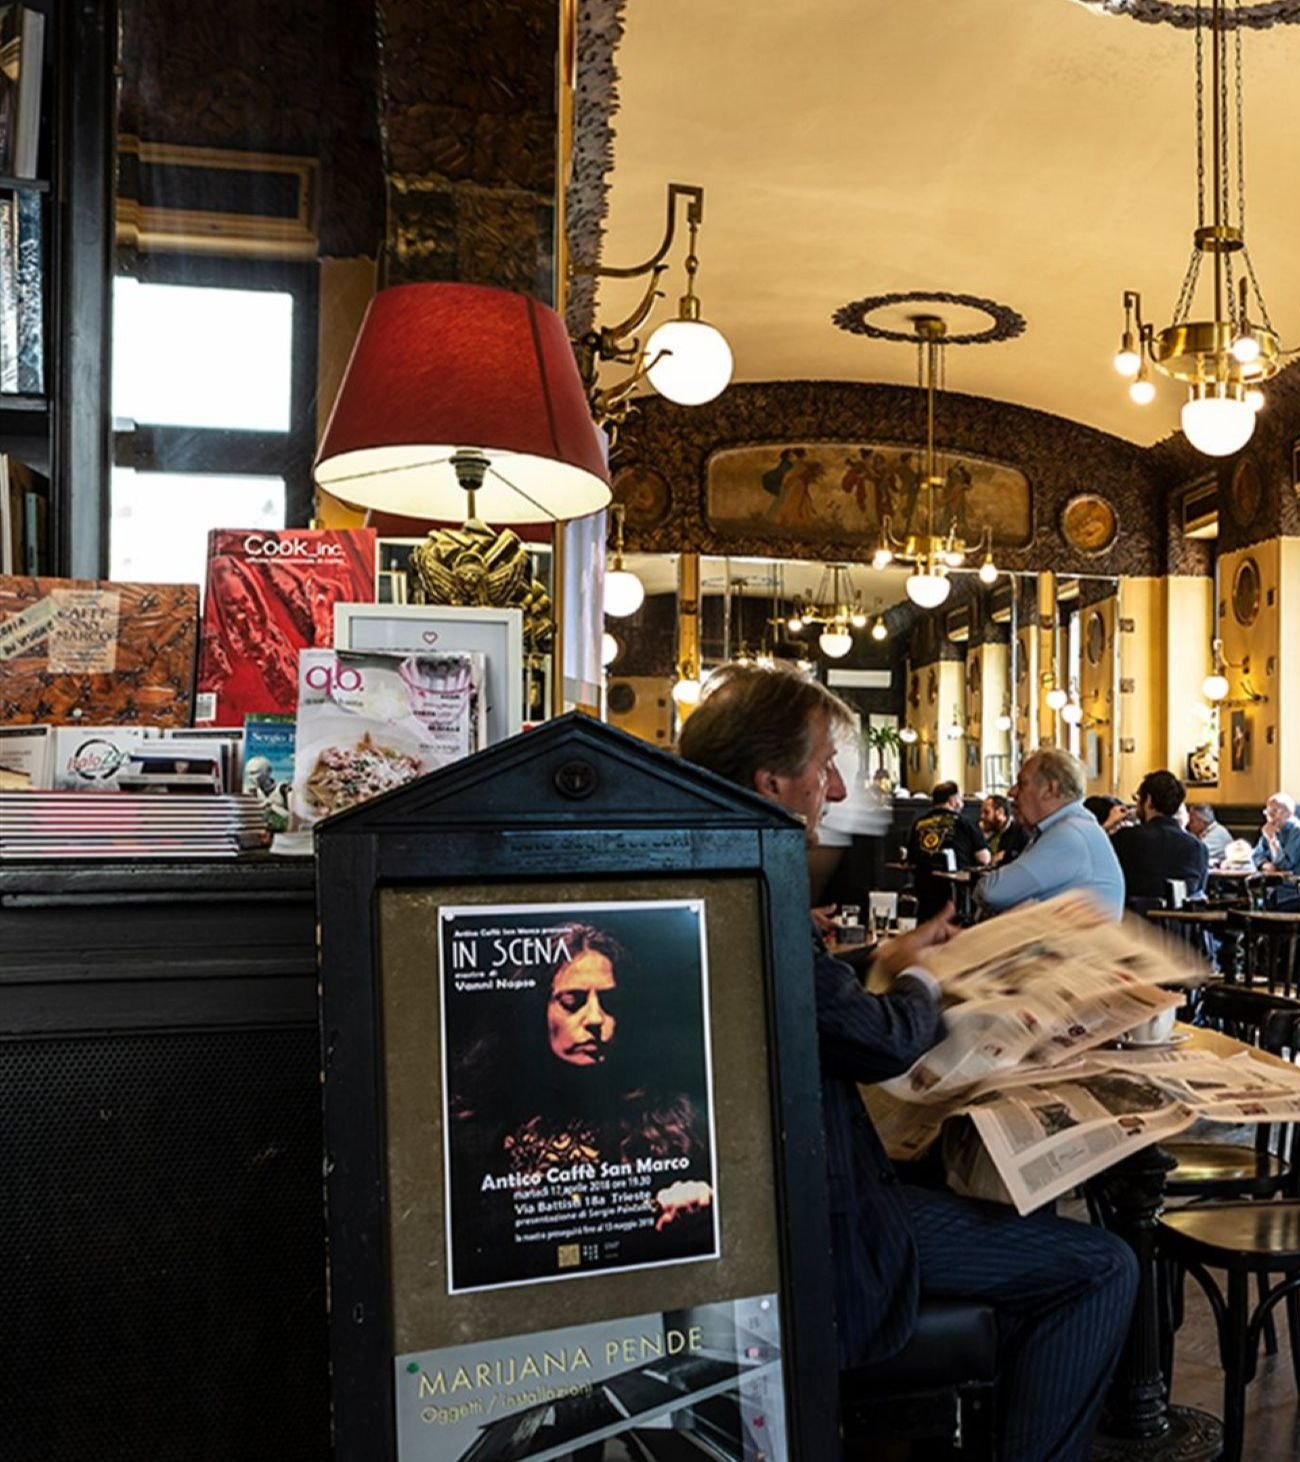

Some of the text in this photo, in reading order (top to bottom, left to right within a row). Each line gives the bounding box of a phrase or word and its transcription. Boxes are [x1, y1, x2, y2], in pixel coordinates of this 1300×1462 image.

[244, 535, 346, 557] Cook_inc.
[453, 937, 572, 968] IN SCENA
[455, 980, 493, 991] Vanni
[481, 1156, 690, 1192] Antico Caffè San Marco
[514, 1203, 535, 1215] Via
[612, 1191, 652, 1203] Trieste
[417, 1325, 705, 1399] MARIJANA PENDE
[420, 1397, 483, 1425] Oggetti
